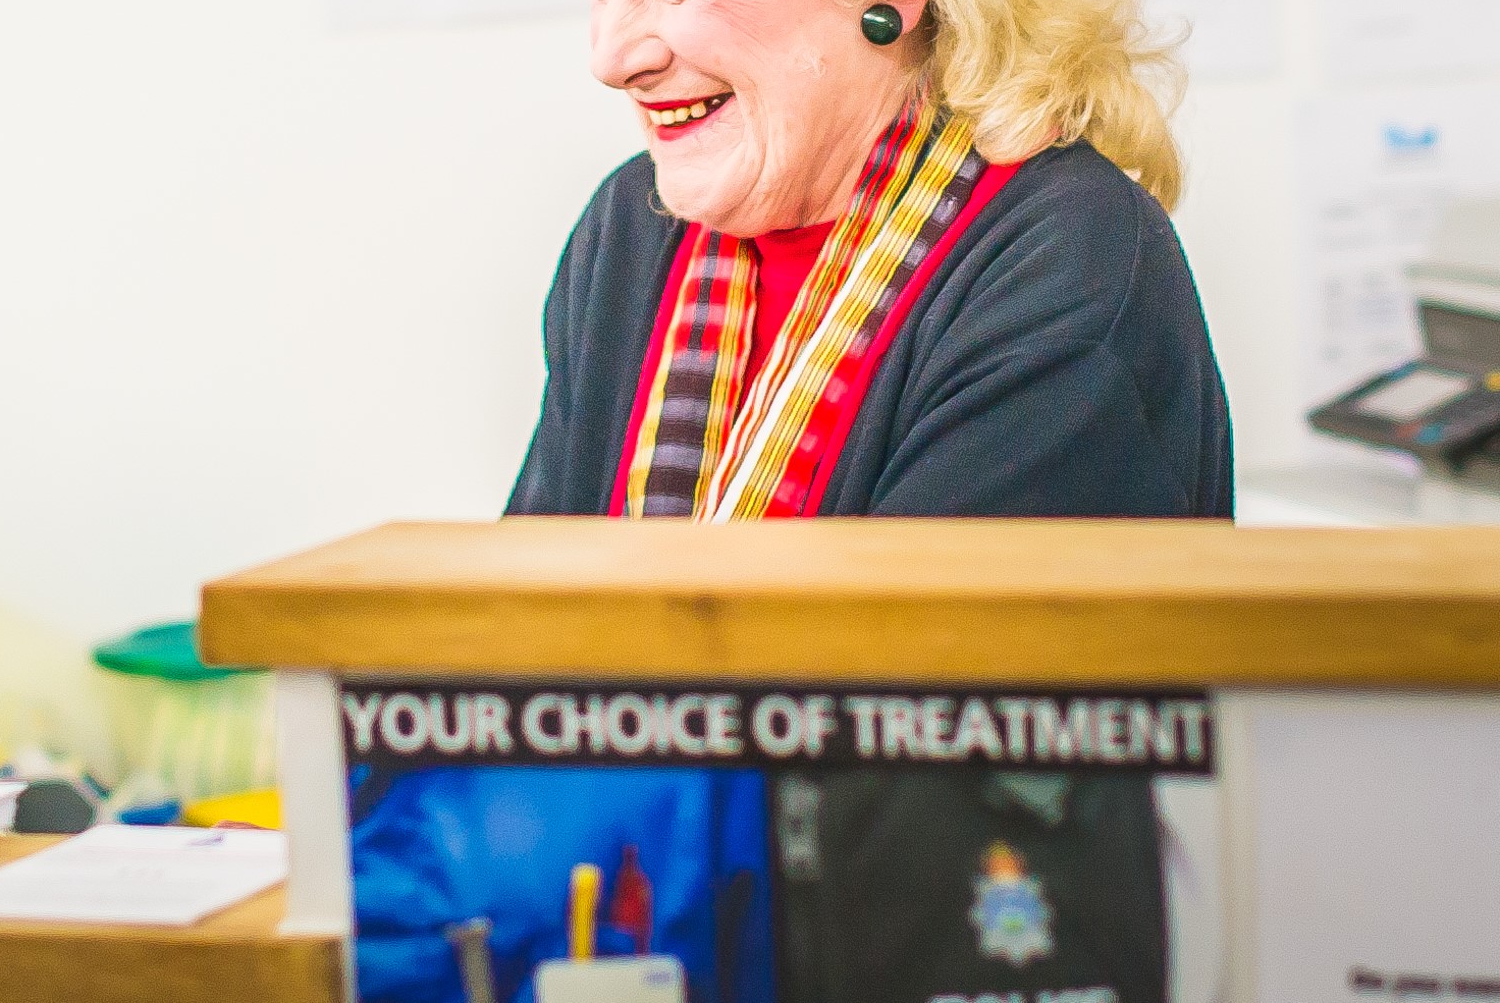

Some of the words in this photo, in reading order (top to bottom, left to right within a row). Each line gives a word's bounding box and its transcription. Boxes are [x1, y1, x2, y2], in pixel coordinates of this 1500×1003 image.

[343, 694, 508, 755] YOUR
[523, 694, 744, 757] CHOICE
[753, 695, 837, 757] OF
[848, 697, 1213, 761] TREATMENT
